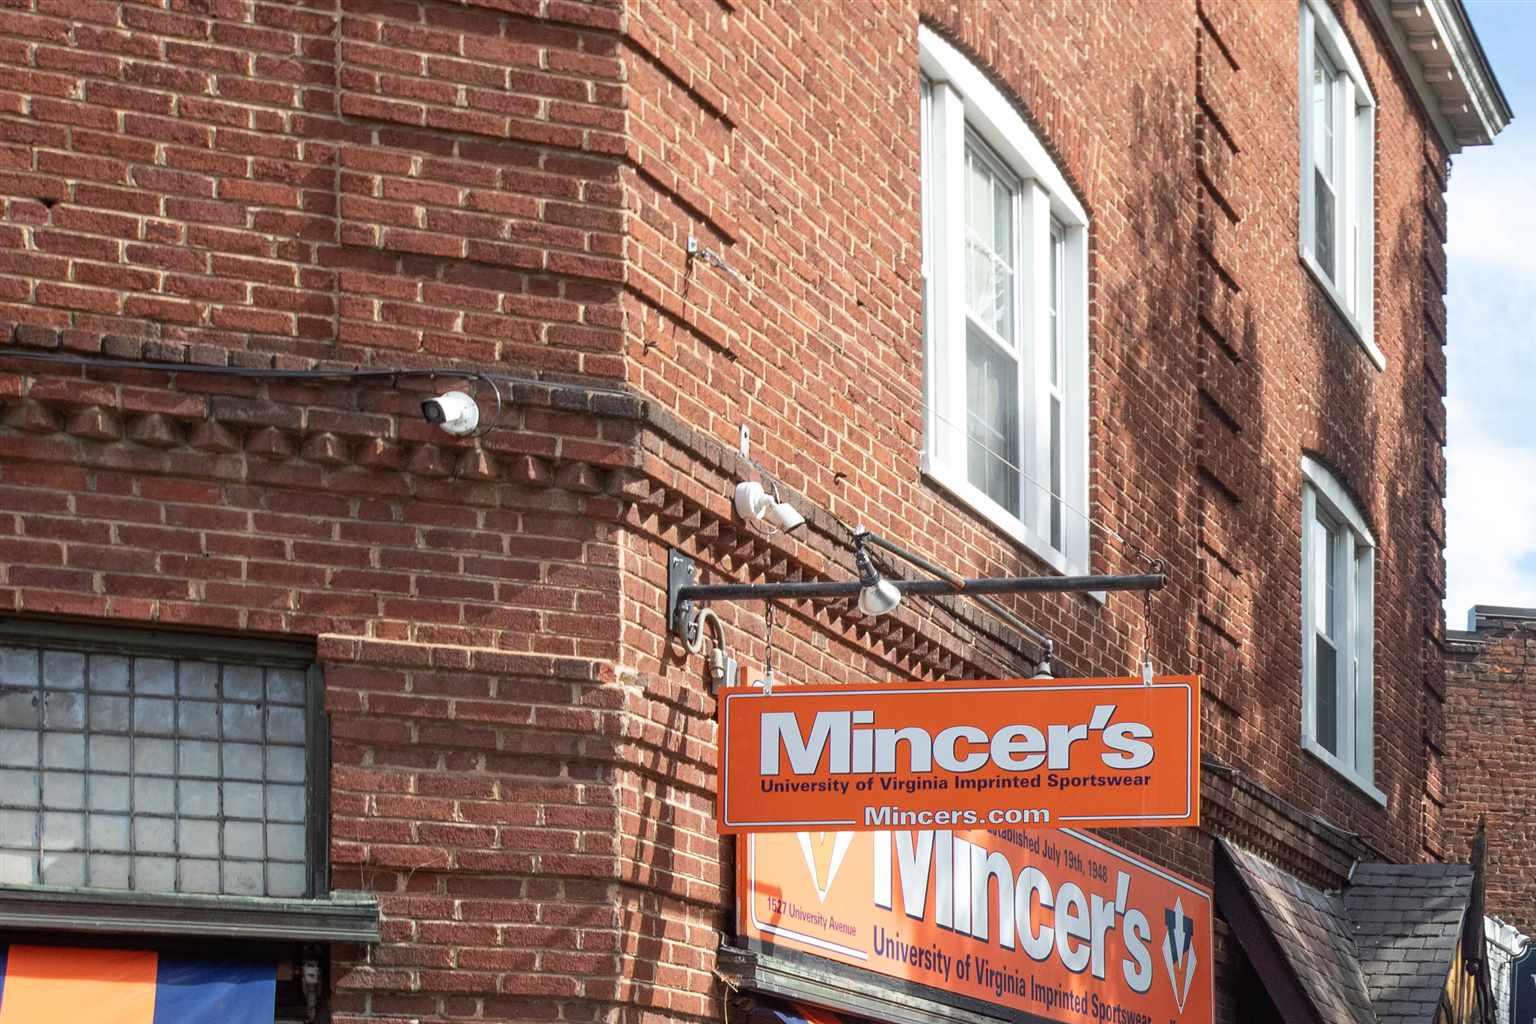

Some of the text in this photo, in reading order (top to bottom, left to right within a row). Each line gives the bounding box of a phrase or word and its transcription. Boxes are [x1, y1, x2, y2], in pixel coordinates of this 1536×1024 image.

[760, 704, 1155, 776] Mincer's
[761, 773, 1151, 794] University of Virginia Imprinted Sportswear
[864, 806, 1050, 826] Mincers.com
[1043, 843, 1108, 883] July 19th, 1948
[767, 896, 857, 937] 1527 University Avenue
[873, 925, 951, 983] University
[956, 954, 971, 981] of
[975, 960, 1026, 997] Virginia
[1031, 975, 1088, 1015] Imprinted
